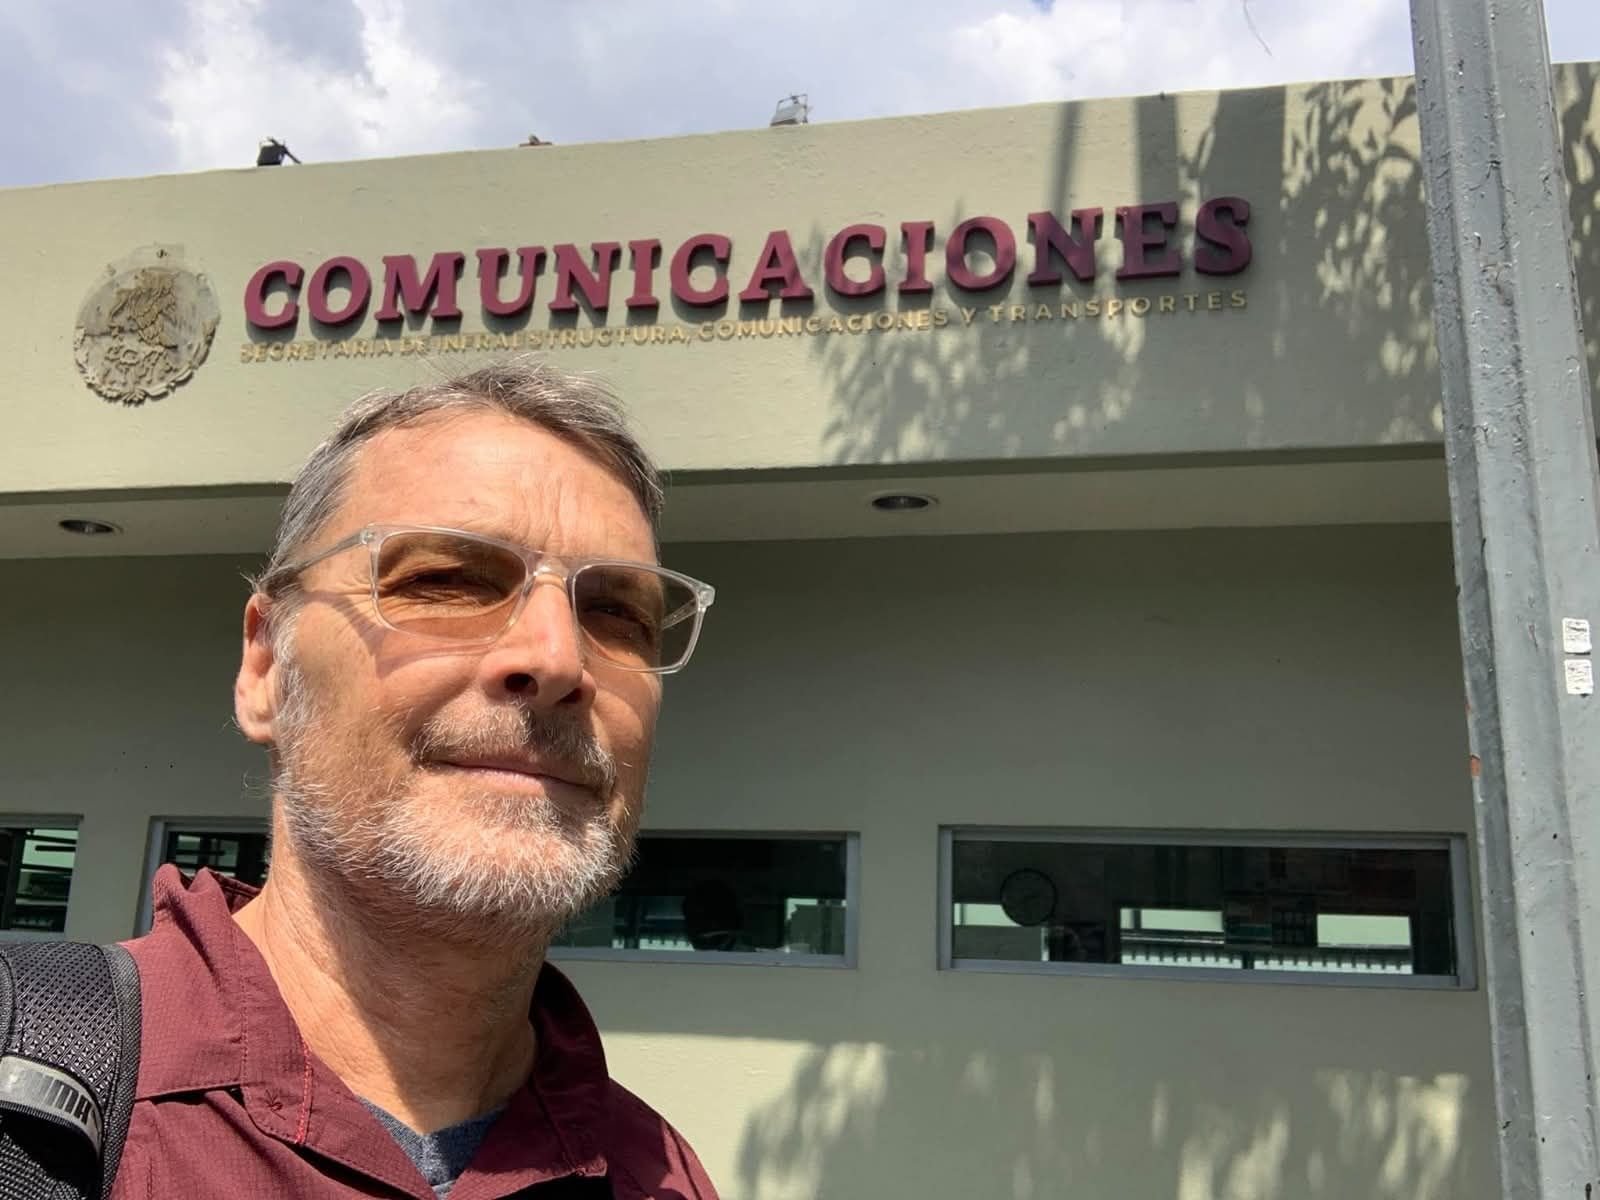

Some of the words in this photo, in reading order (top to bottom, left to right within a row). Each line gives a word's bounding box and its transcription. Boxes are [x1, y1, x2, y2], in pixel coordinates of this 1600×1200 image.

[244, 196, 1254, 331] COMUNICACIONES
[400, 336, 430, 356] DE
[699, 308, 949, 341] COMUNICACIONES
[960, 307, 978, 325] Y
[988, 290, 1249, 323] TRANSPORTES
